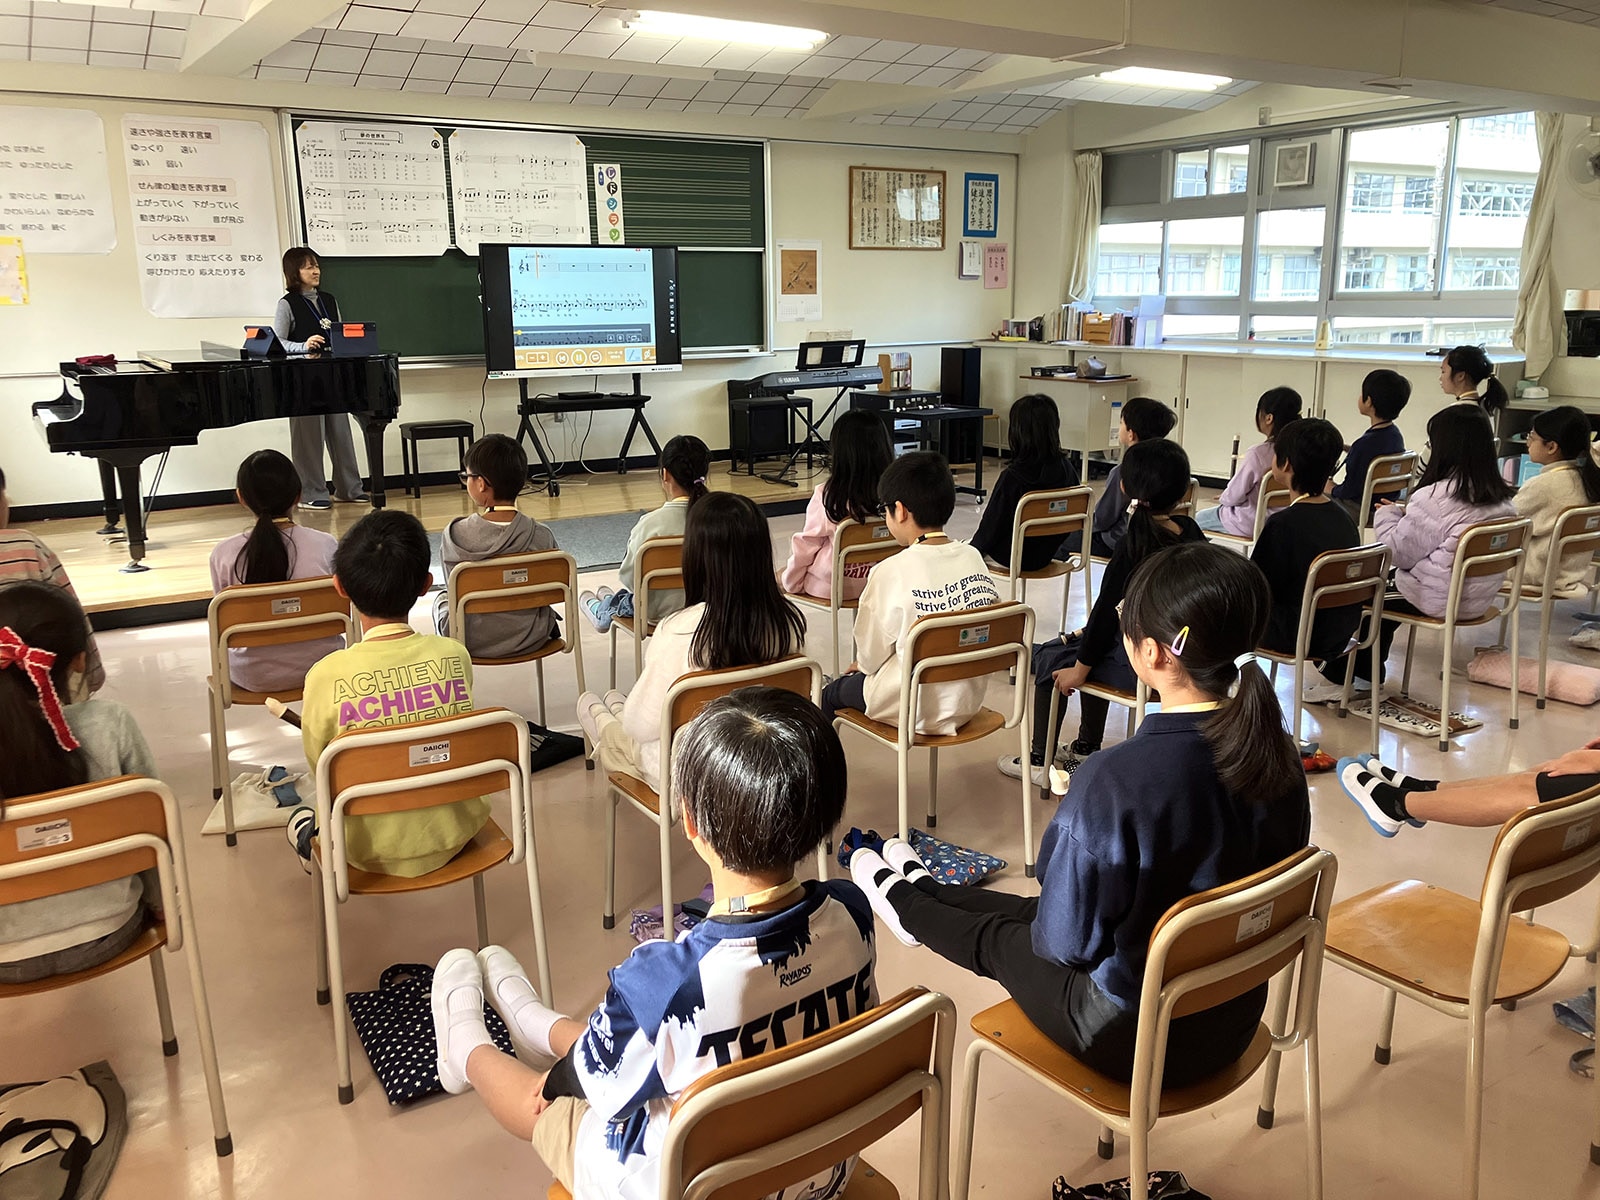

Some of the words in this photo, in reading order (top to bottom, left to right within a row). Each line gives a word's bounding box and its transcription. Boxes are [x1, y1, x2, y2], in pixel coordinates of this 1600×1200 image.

[129, 127, 213, 140] 速さや強さを表す言葉
[130, 143, 164, 153] ゆっくり
[19, 161, 73, 170] ゆったりとした
[132, 158, 150, 167] 強い
[166, 159, 183, 168] 弱い
[138, 182, 227, 193] せん律の動きを表す言葉
[136, 199, 184, 208] 上がっていく
[192, 200, 240, 210] 下がっていく
[4, 207, 50, 216] かわいらしい
[57, 208, 95, 217] なめらかな
[139, 214, 190, 223] 動きが少ない
[213, 215, 245, 224] 音が飛ぶ
[152, 233, 217, 243] しくみを表す言葉
[145, 253, 177, 262] くり返す
[186, 254, 233, 262] また出てくる
[240, 254, 264, 262] 変わる
[146, 268, 195, 277] 呼びかけたり
[783, 376, 800, 384] YAMAHA
[912, 589, 944, 599] strive
[945, 583, 958, 595] for
[915, 601, 947, 612] strive
[948, 594, 961, 608] for
[333, 656, 464, 704] ACHIEVE
[339, 679, 469, 727] ACHIEVE
[423, 743, 449, 752] DAIICHI
[442, 753, 448, 761] 3
[62, 833, 70, 842] 3
